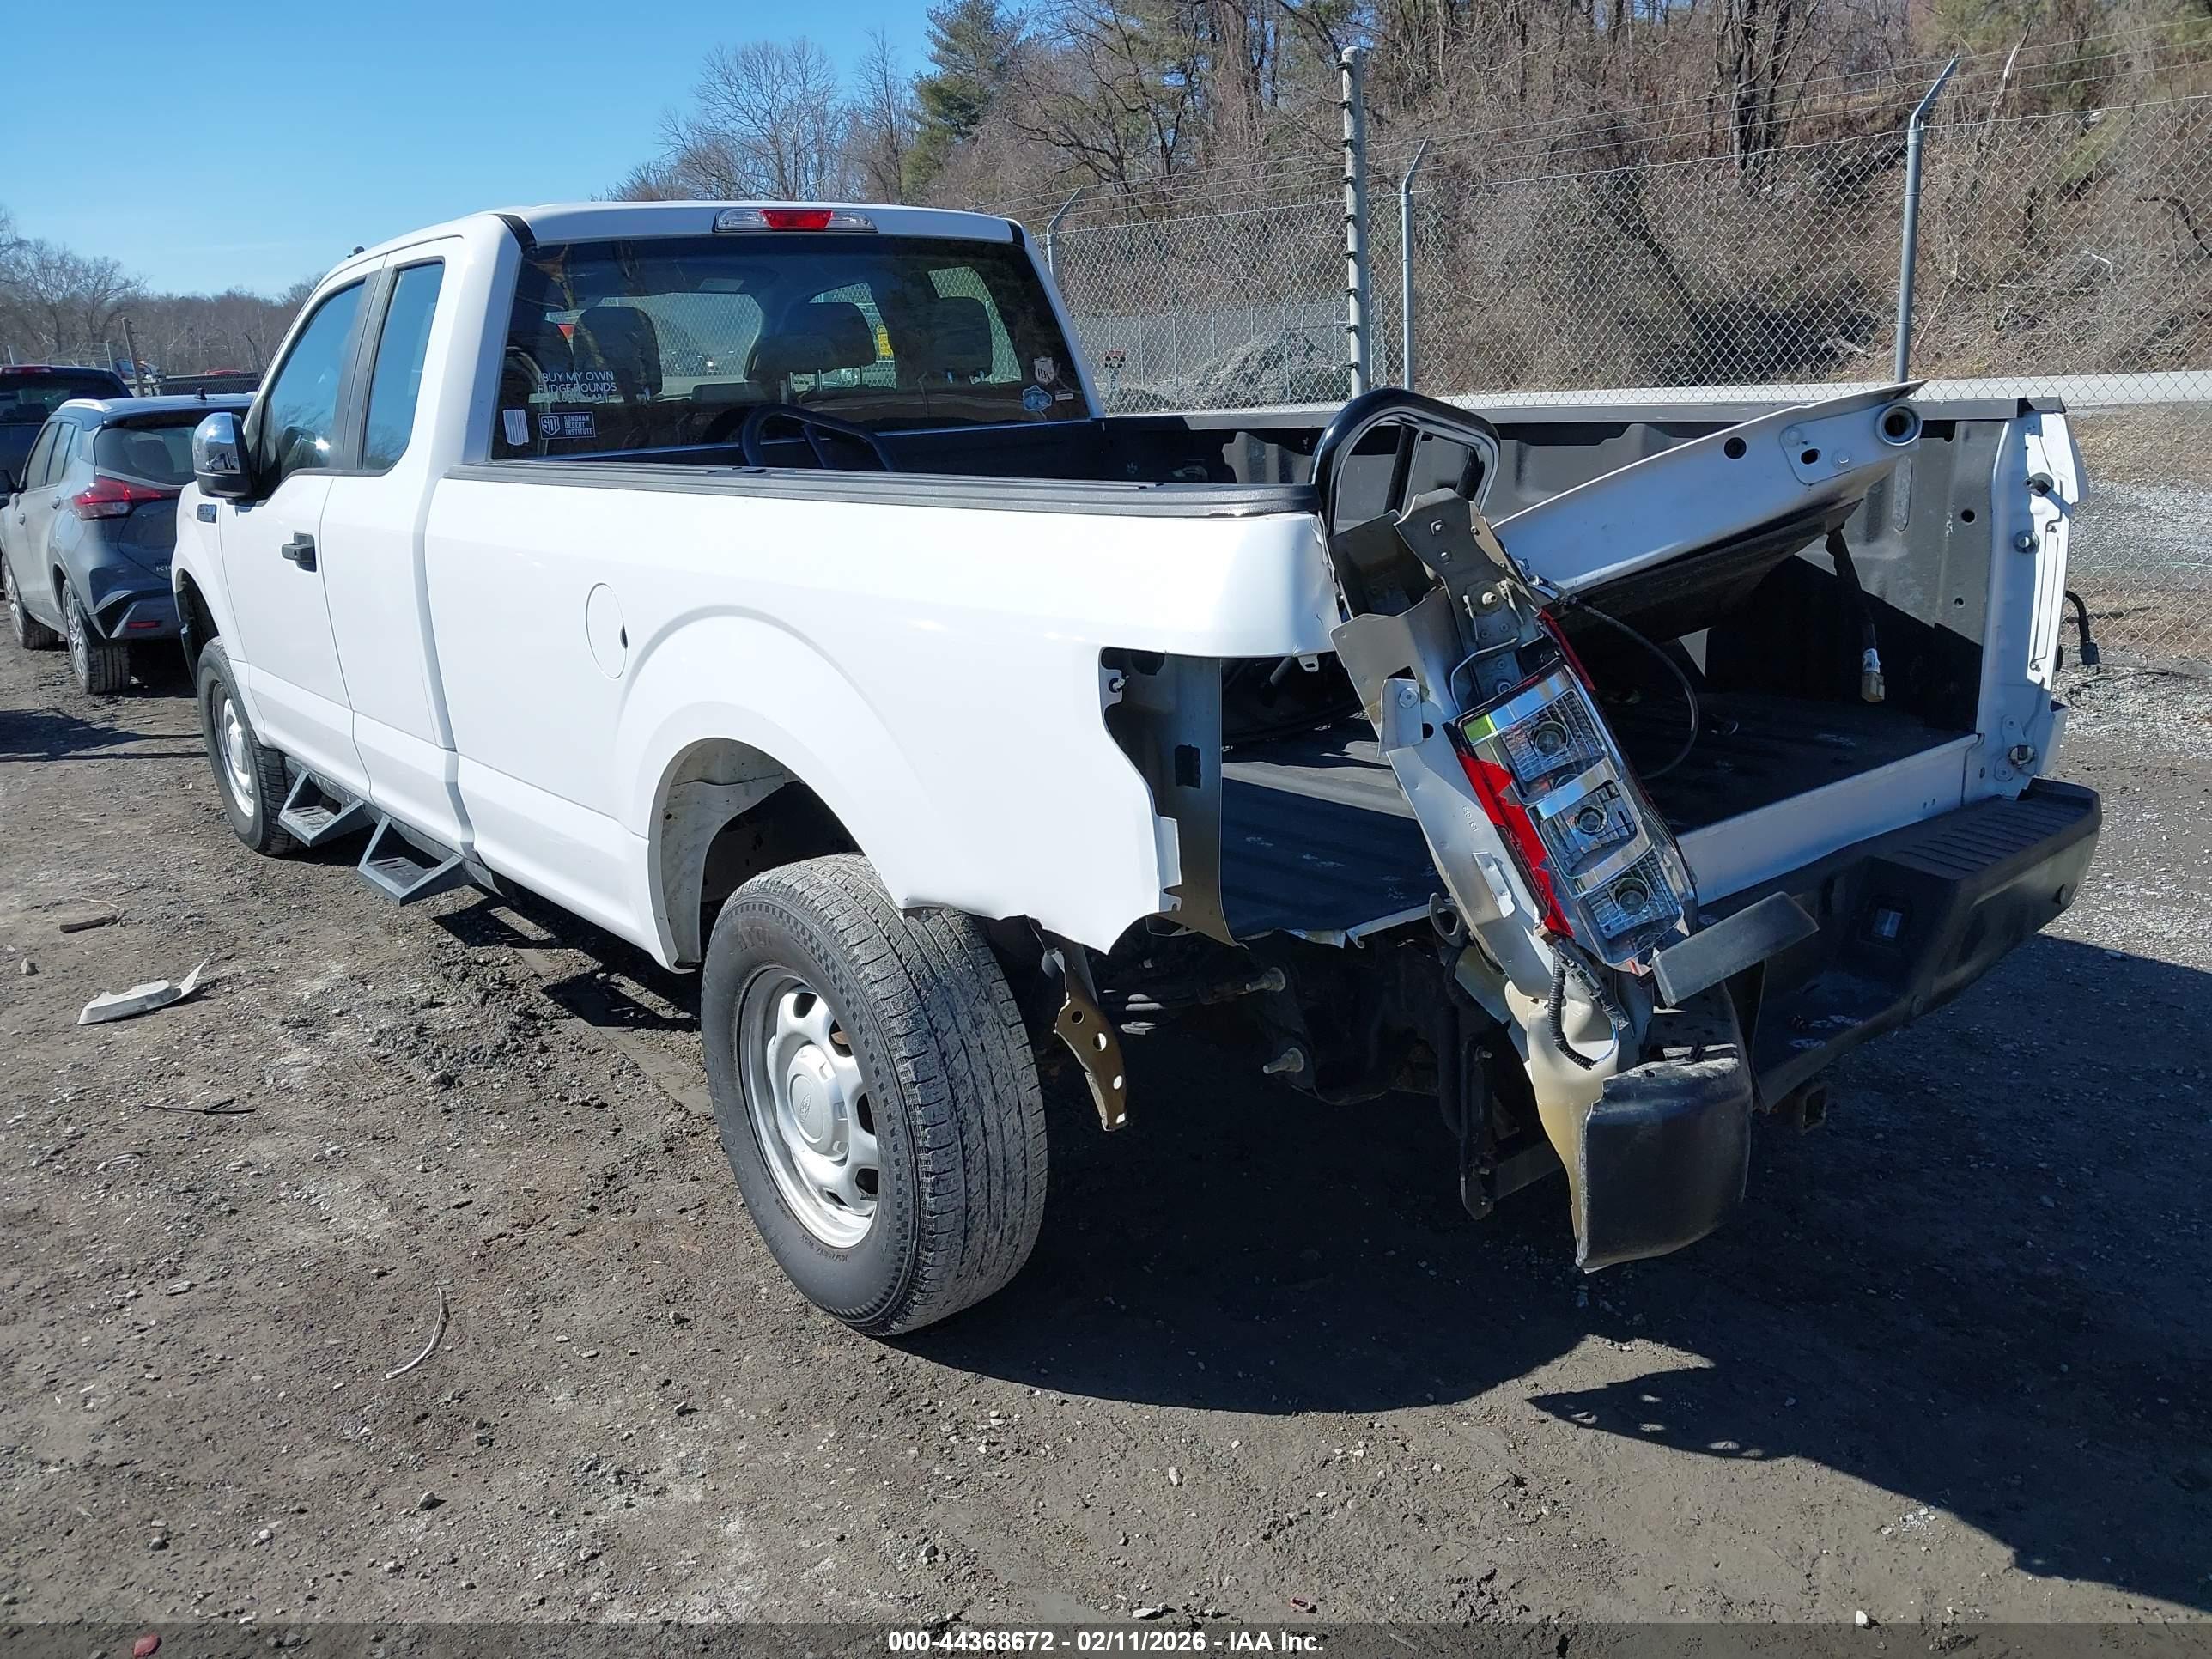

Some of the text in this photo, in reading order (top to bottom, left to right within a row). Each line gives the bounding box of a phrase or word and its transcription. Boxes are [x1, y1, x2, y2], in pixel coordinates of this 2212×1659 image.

[543, 372, 563, 382] BUY
[566, 371, 583, 381] MY
[585, 371, 614, 380] OWN
[538, 384, 571, 393] FUDGE
[542, 416, 558, 434] SDI
